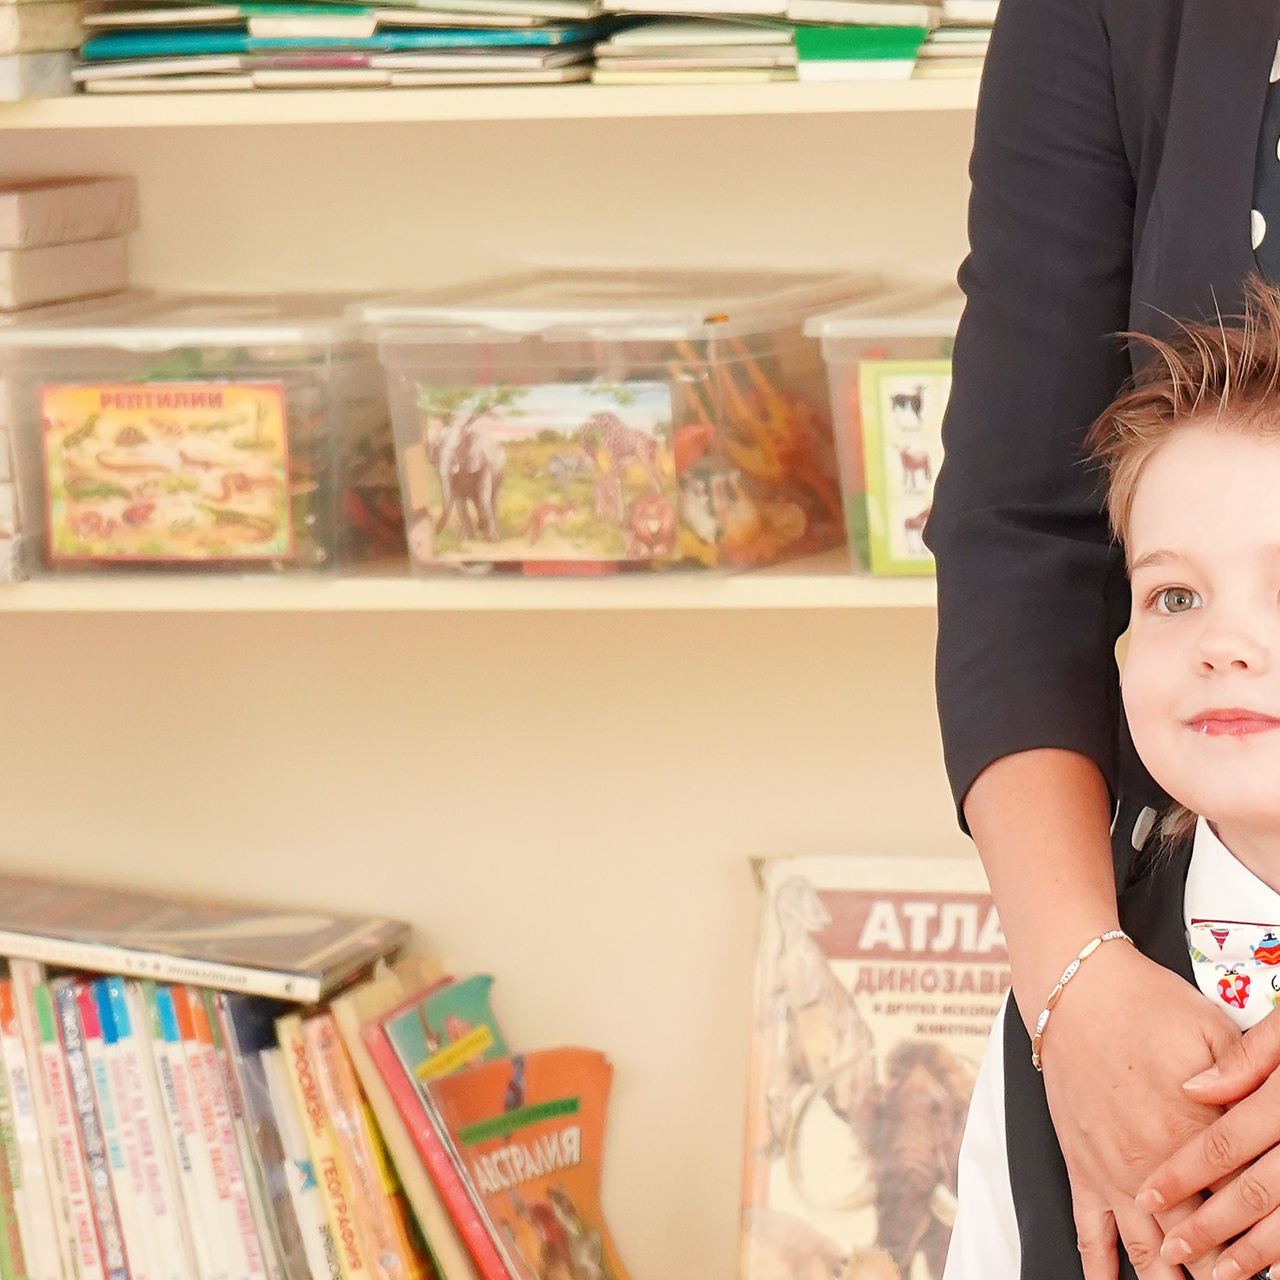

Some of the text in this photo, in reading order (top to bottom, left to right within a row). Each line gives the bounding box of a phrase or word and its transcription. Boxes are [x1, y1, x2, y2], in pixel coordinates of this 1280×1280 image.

[100, 391, 225, 410] РЕПТИЛИИ
[854, 968, 1011, 995] ДИНОЗАВР
[473, 1126, 582, 1197] АВСТРАЛИЯ
[320, 1155, 363, 1272] ГЕОГРАФИЯ
